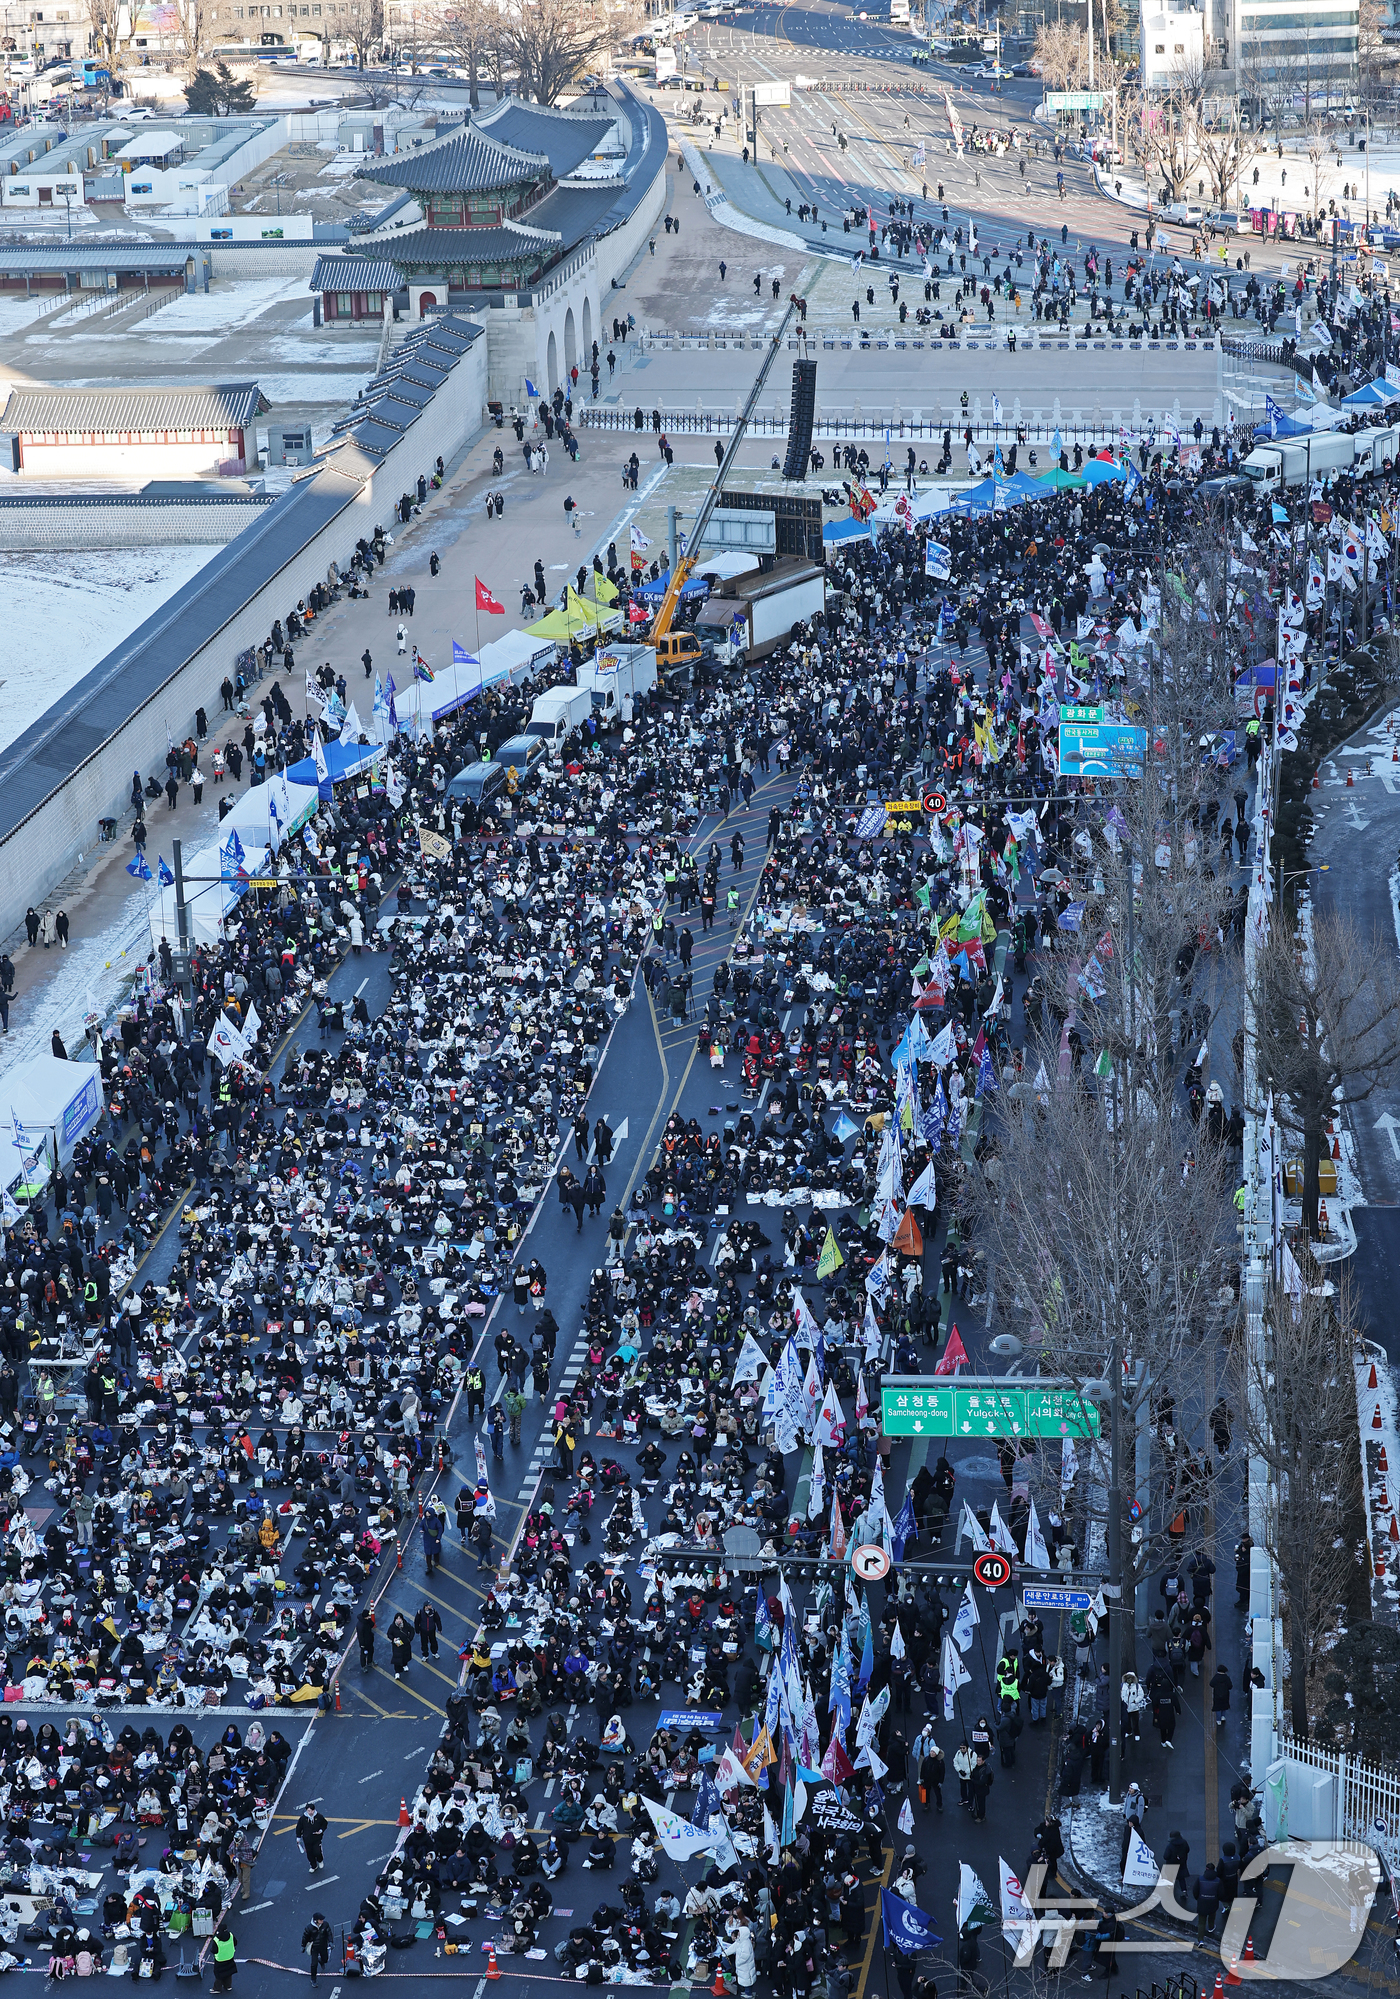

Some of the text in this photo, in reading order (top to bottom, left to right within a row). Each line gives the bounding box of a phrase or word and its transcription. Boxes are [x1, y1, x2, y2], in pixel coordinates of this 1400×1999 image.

[1066, 708, 1098, 719] 광화문
[928, 798, 941, 808] 40
[896, 1395, 939, 1407] 삼청동
[968, 1395, 1012, 1408] 율곡로
[1040, 1395, 1062, 1405] 시청
[887, 1408, 948, 1418] Samcheong-dong
[966, 1409, 1015, 1418] Yulgok-ro
[1031, 1407, 1063, 1418] 시의회
[983, 1562, 1002, 1578] 40
